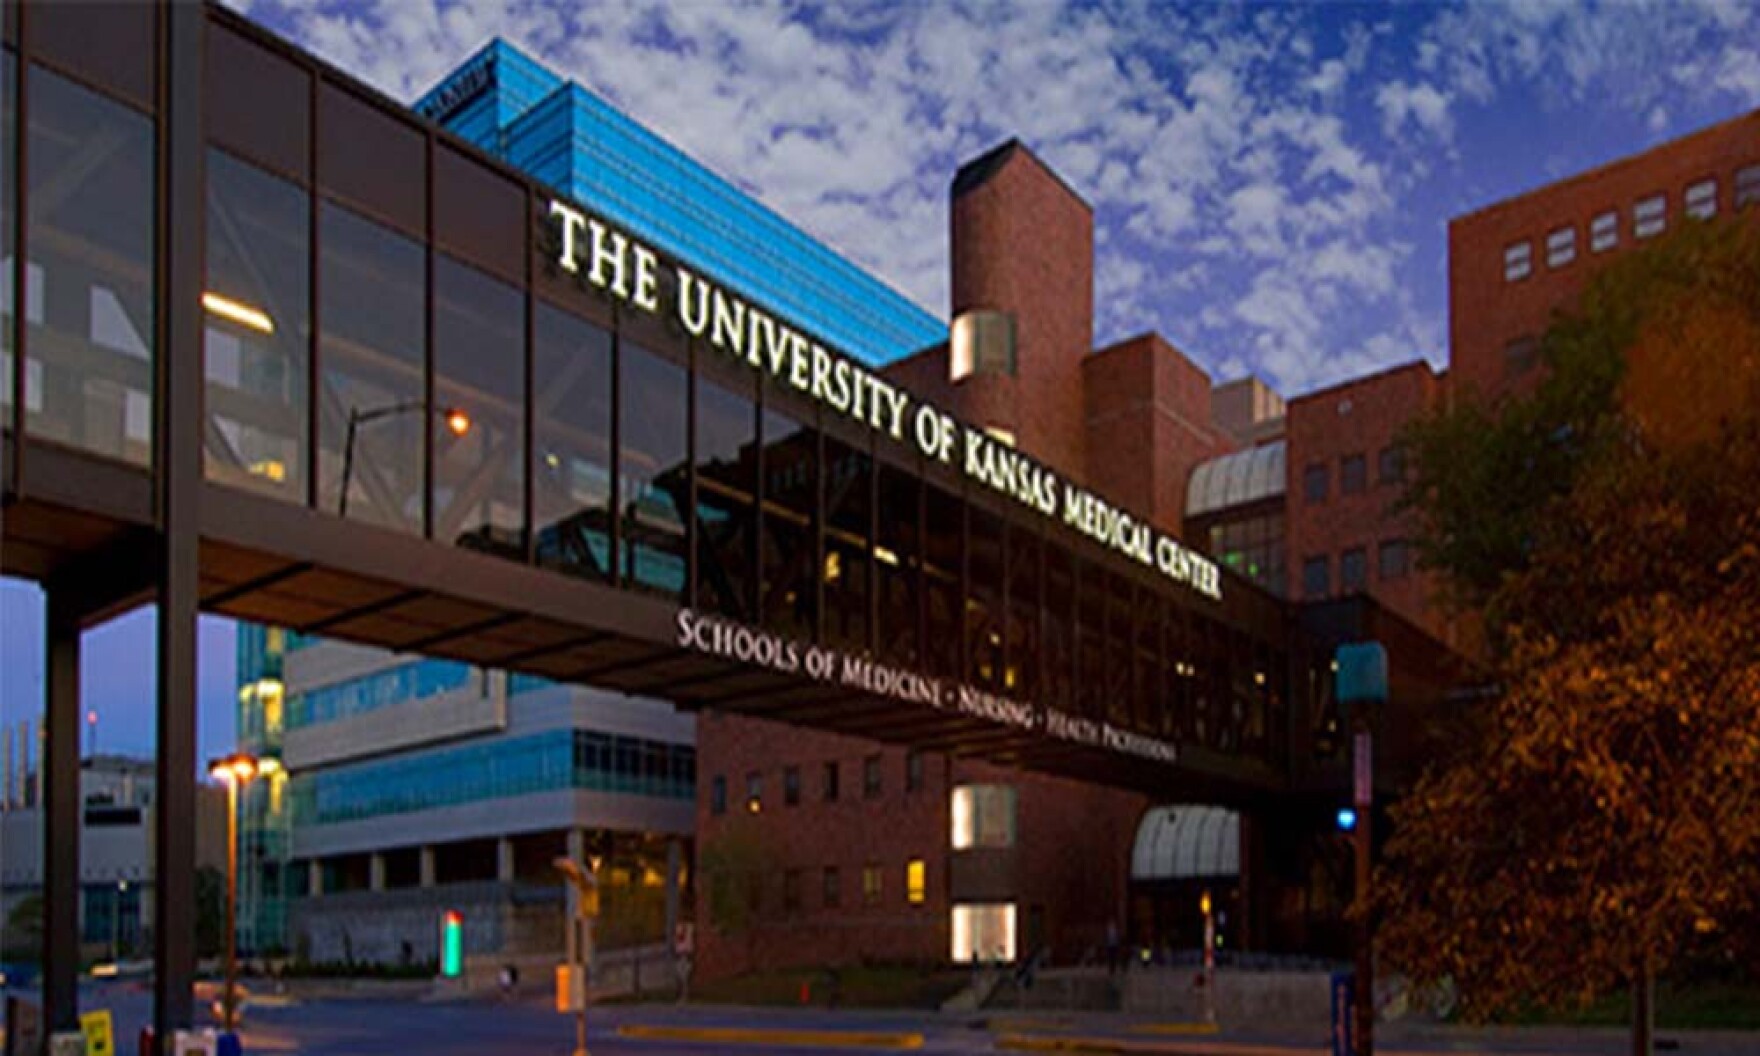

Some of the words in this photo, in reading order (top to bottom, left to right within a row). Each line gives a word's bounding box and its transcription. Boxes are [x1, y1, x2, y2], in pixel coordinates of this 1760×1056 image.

[550, 199, 658, 311] THE
[677, 268, 908, 440] UNIVERSITY
[916, 405, 957, 462] OF
[964, 429, 1056, 516] KANSAS
[1063, 484, 1154, 565] MEDICAL
[1156, 535, 1222, 599] CENTER
[677, 608, 798, 673] SCHOOLS
[805, 647, 836, 681] OF
[841, 655, 942, 708] MEDICINE
